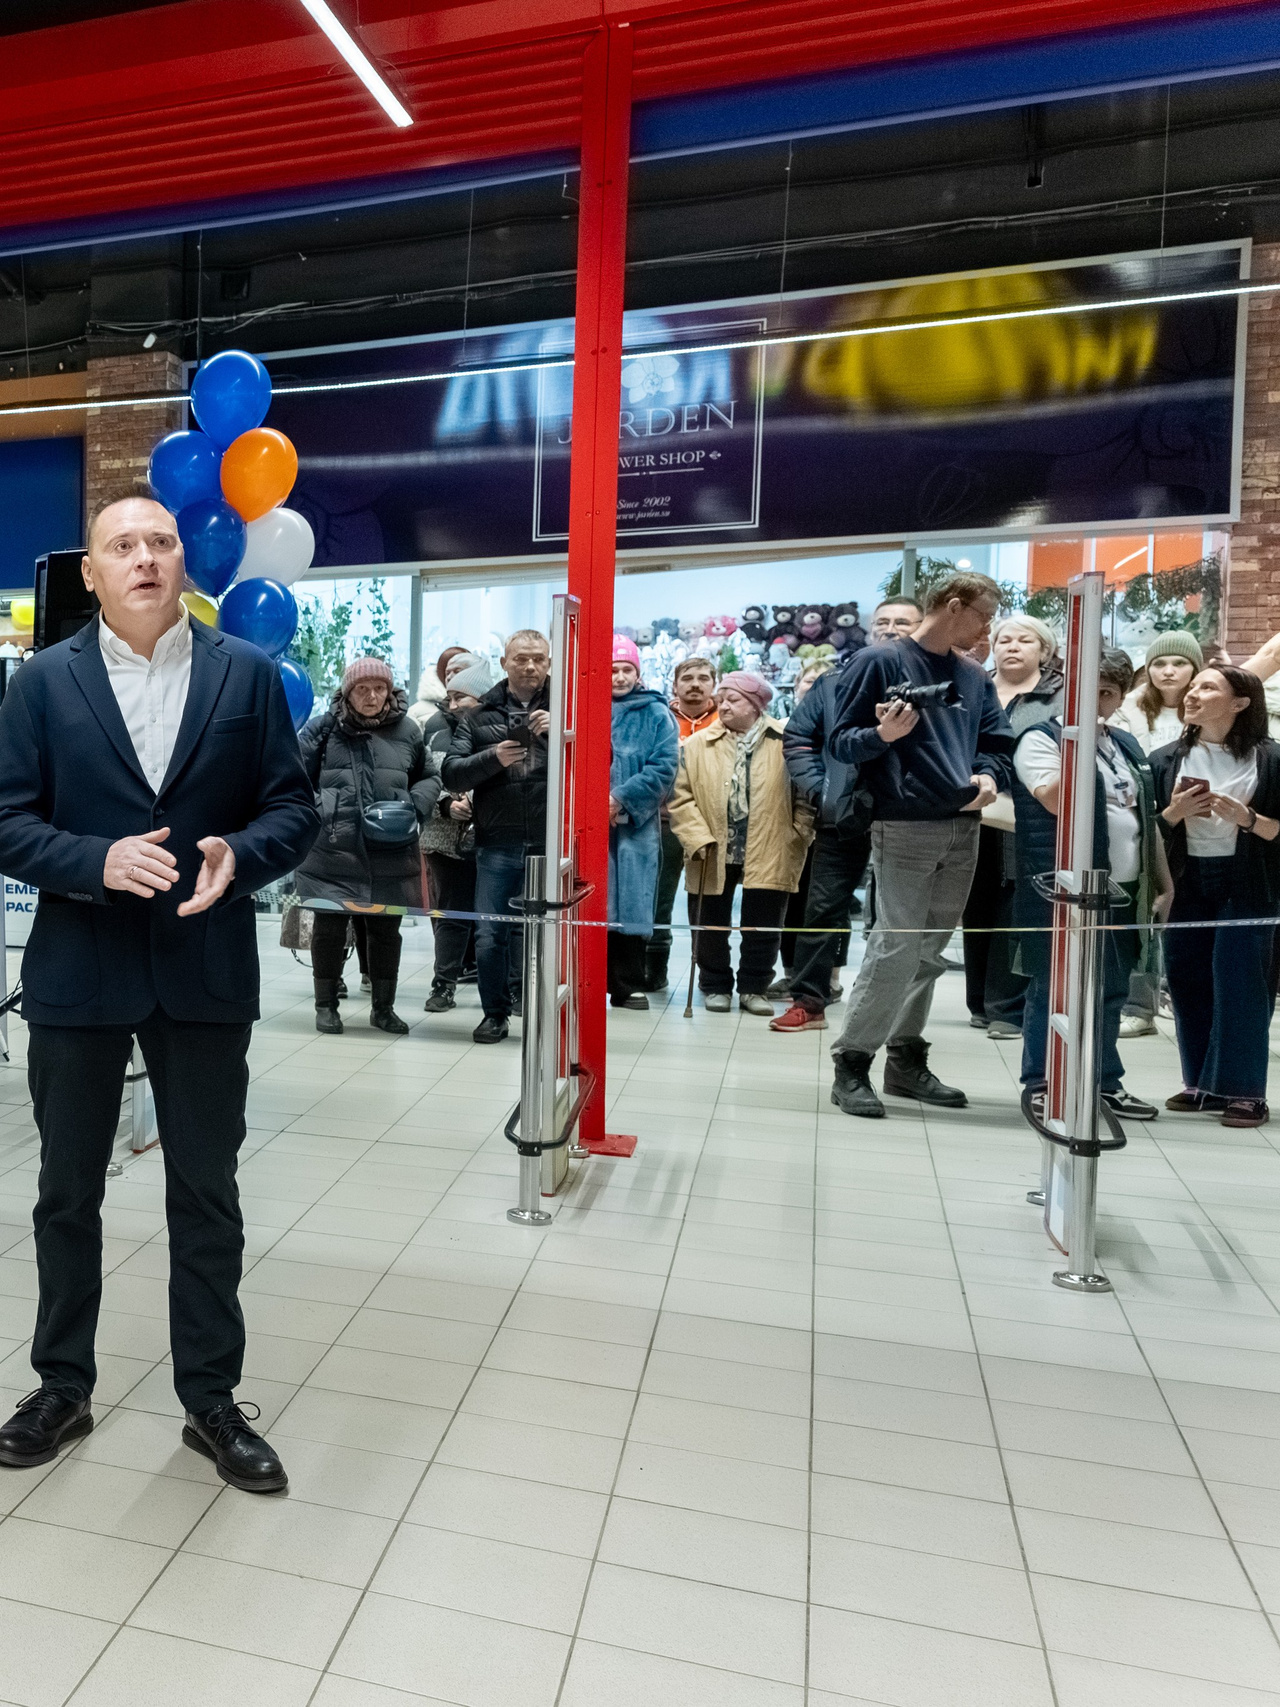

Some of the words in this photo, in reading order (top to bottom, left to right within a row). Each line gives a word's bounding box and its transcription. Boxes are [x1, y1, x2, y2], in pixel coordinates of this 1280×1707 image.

[557, 400, 738, 444] JRDEN
[618, 454, 656, 469] WER
[659, 450, 706, 466] SHOP
[616, 499, 640, 510] Since
[642, 495, 672, 508] 2002
[5, 902, 38, 913] РАС
